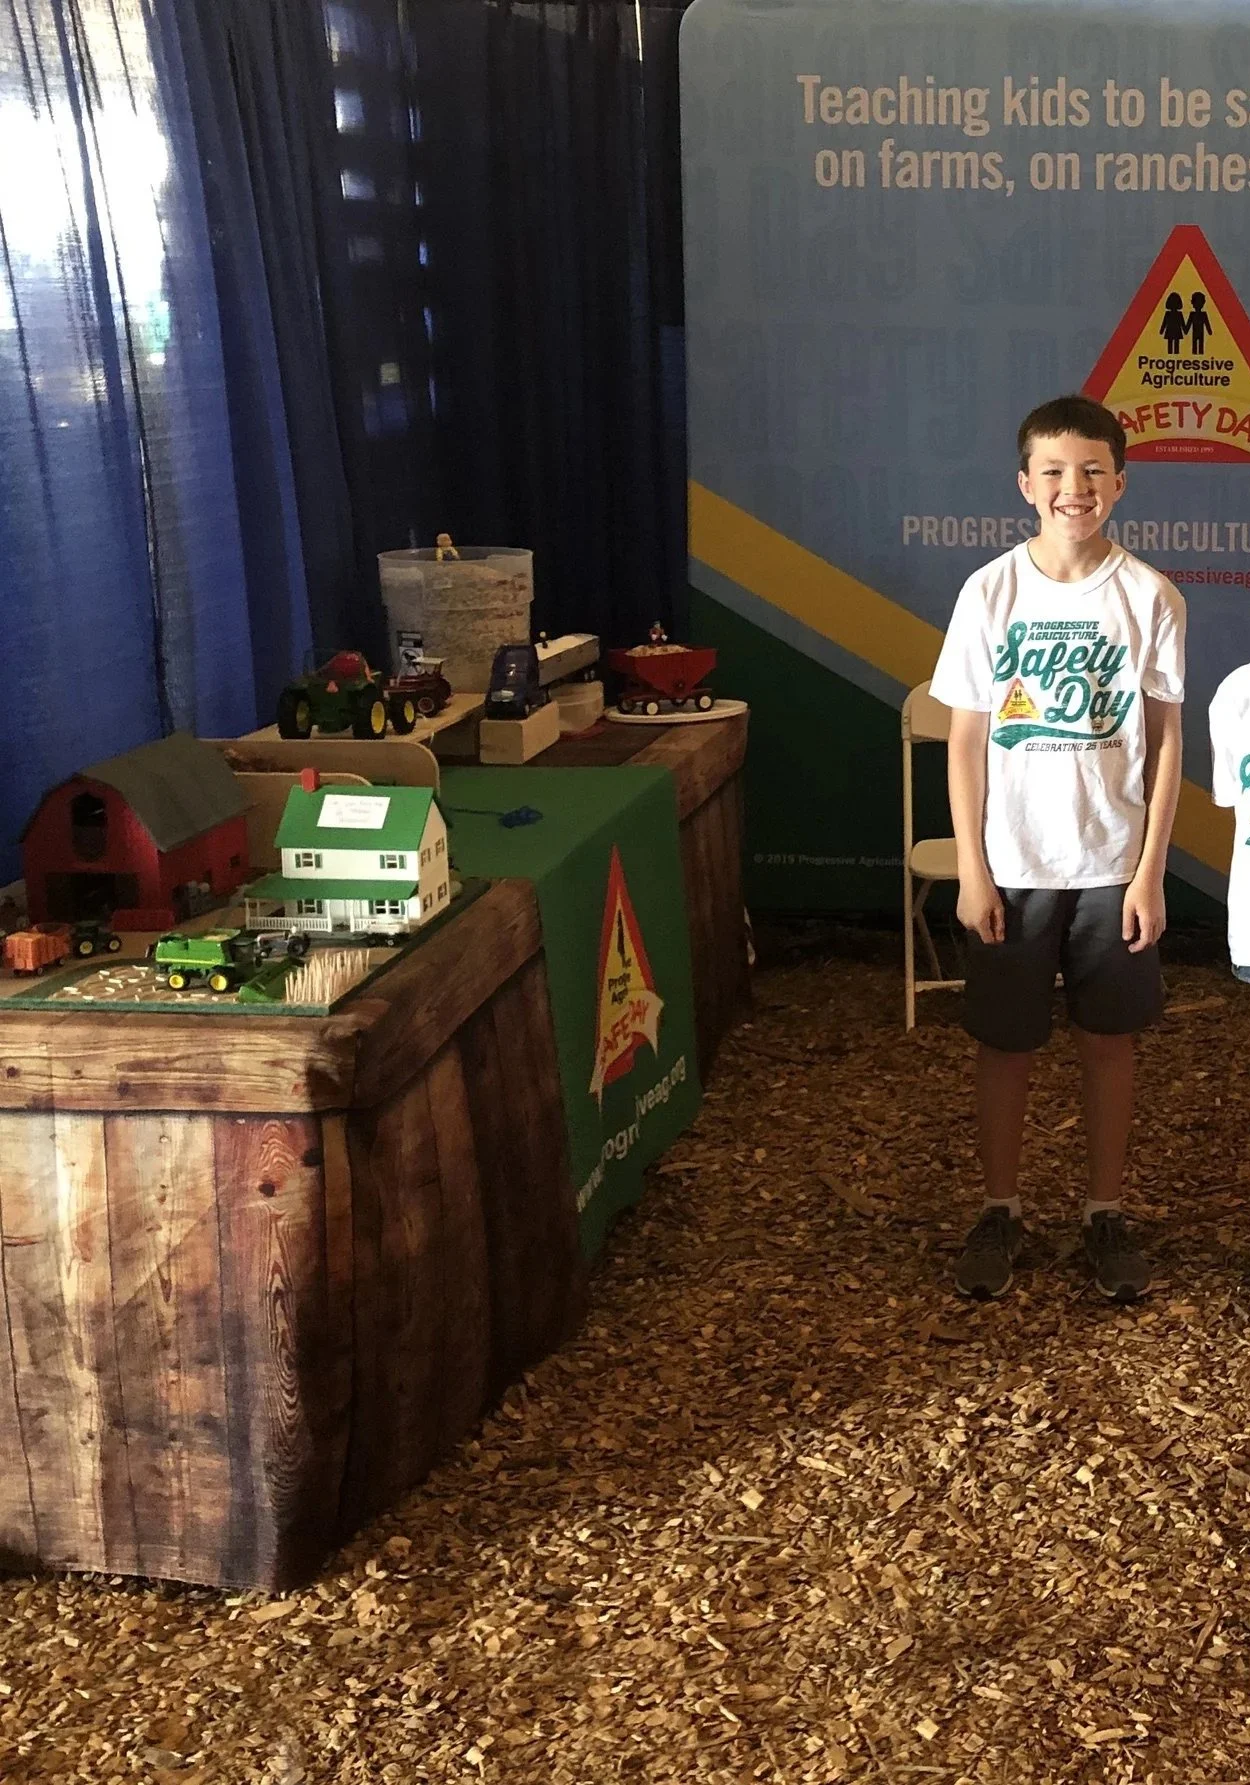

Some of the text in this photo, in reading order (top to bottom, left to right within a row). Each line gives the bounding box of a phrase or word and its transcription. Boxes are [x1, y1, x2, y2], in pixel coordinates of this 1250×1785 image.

[797, 75, 990, 136] Teaching
[1003, 76, 1090, 126] kids
[1103, 79, 1145, 127] to
[1160, 77, 1211, 127] be
[815, 149, 865, 188] on
[878, 138, 1014, 197] farms,
[1030, 152, 1080, 190] on
[1138, 356, 1234, 375] Progressive
[1141, 372, 1230, 389] Agriculture
[1118, 401, 1212, 435] AFETY
[902, 515, 1041, 548] PROGRES
[1027, 631, 1099, 642] AGRICULTURE
[1030, 620, 1100, 631] PROGRESSIVE
[993, 621, 1128, 691] Safety
[1044, 675, 1136, 730] Day
[1025, 739, 1124, 752] CELEBRATING 25 YEARS
